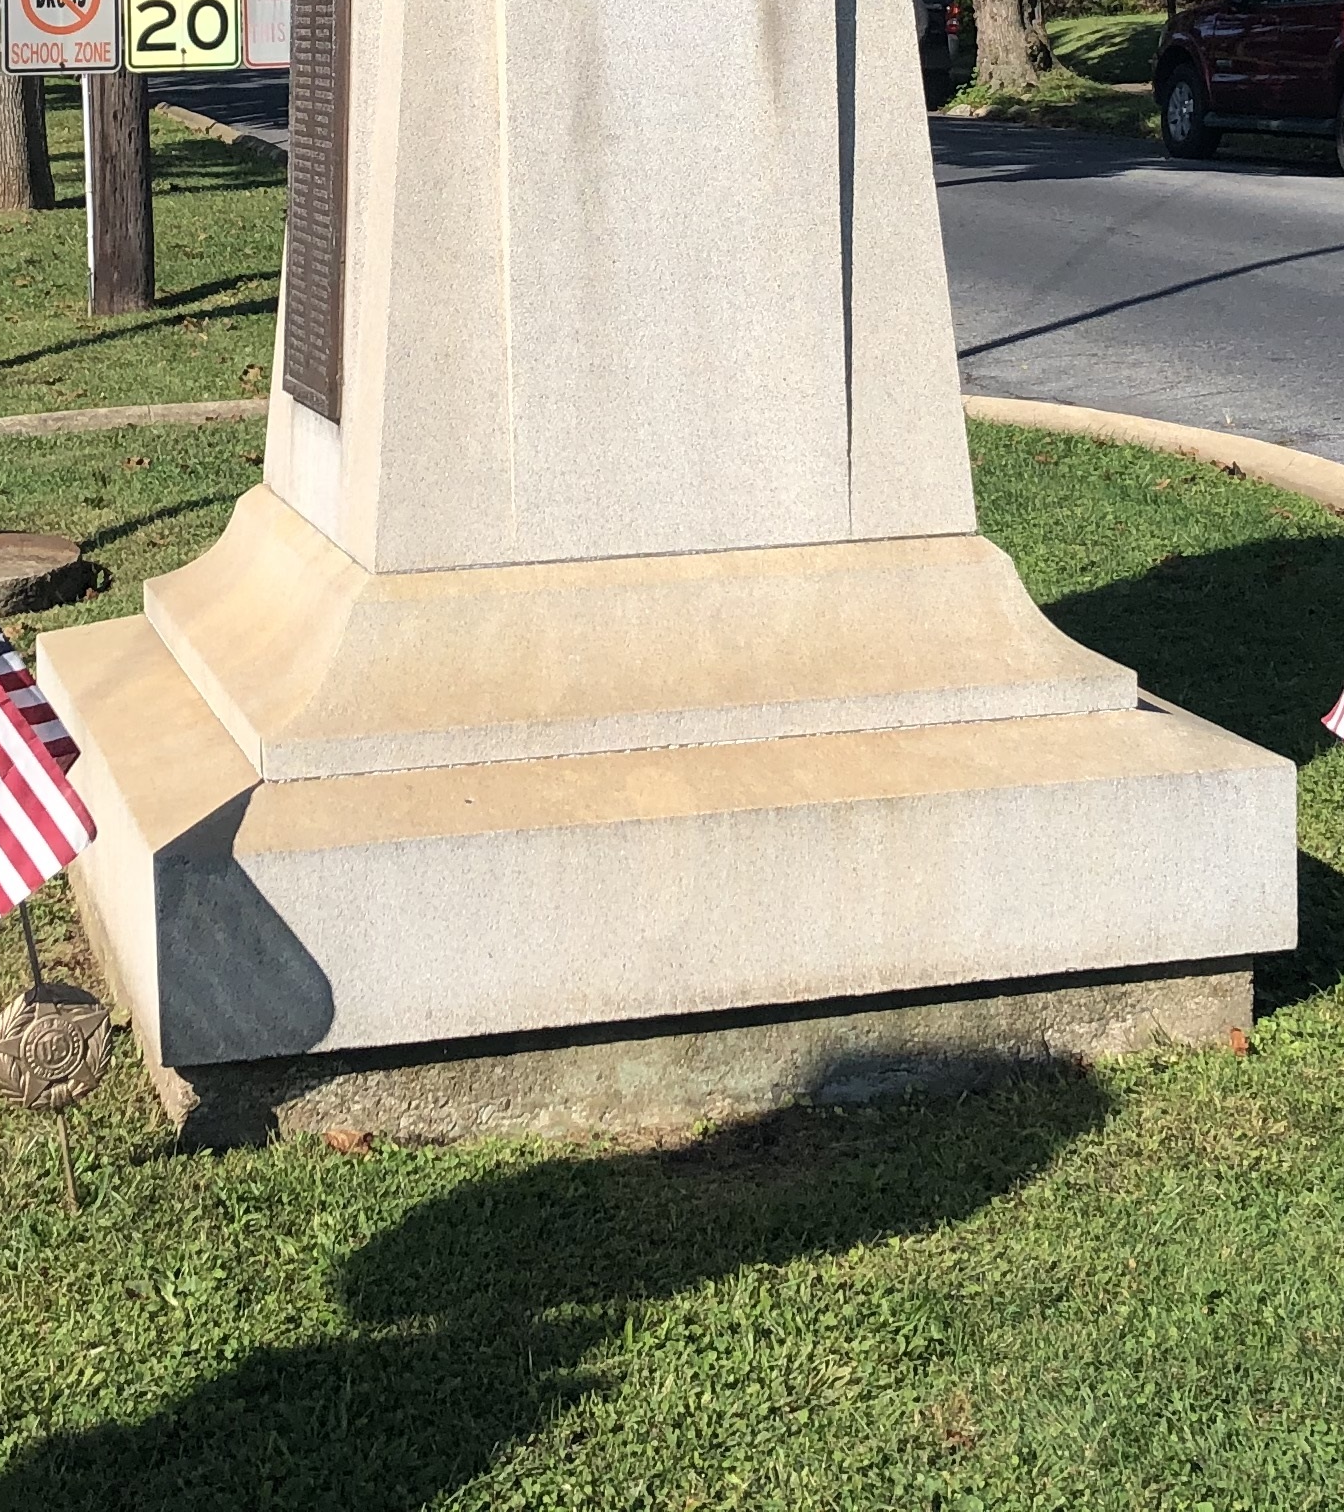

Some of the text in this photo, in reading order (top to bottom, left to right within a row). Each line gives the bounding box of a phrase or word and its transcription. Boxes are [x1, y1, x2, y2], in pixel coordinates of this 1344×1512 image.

[251, 23, 286, 44] THIS
[11, 41, 112, 65] SCHOOL ZONE
